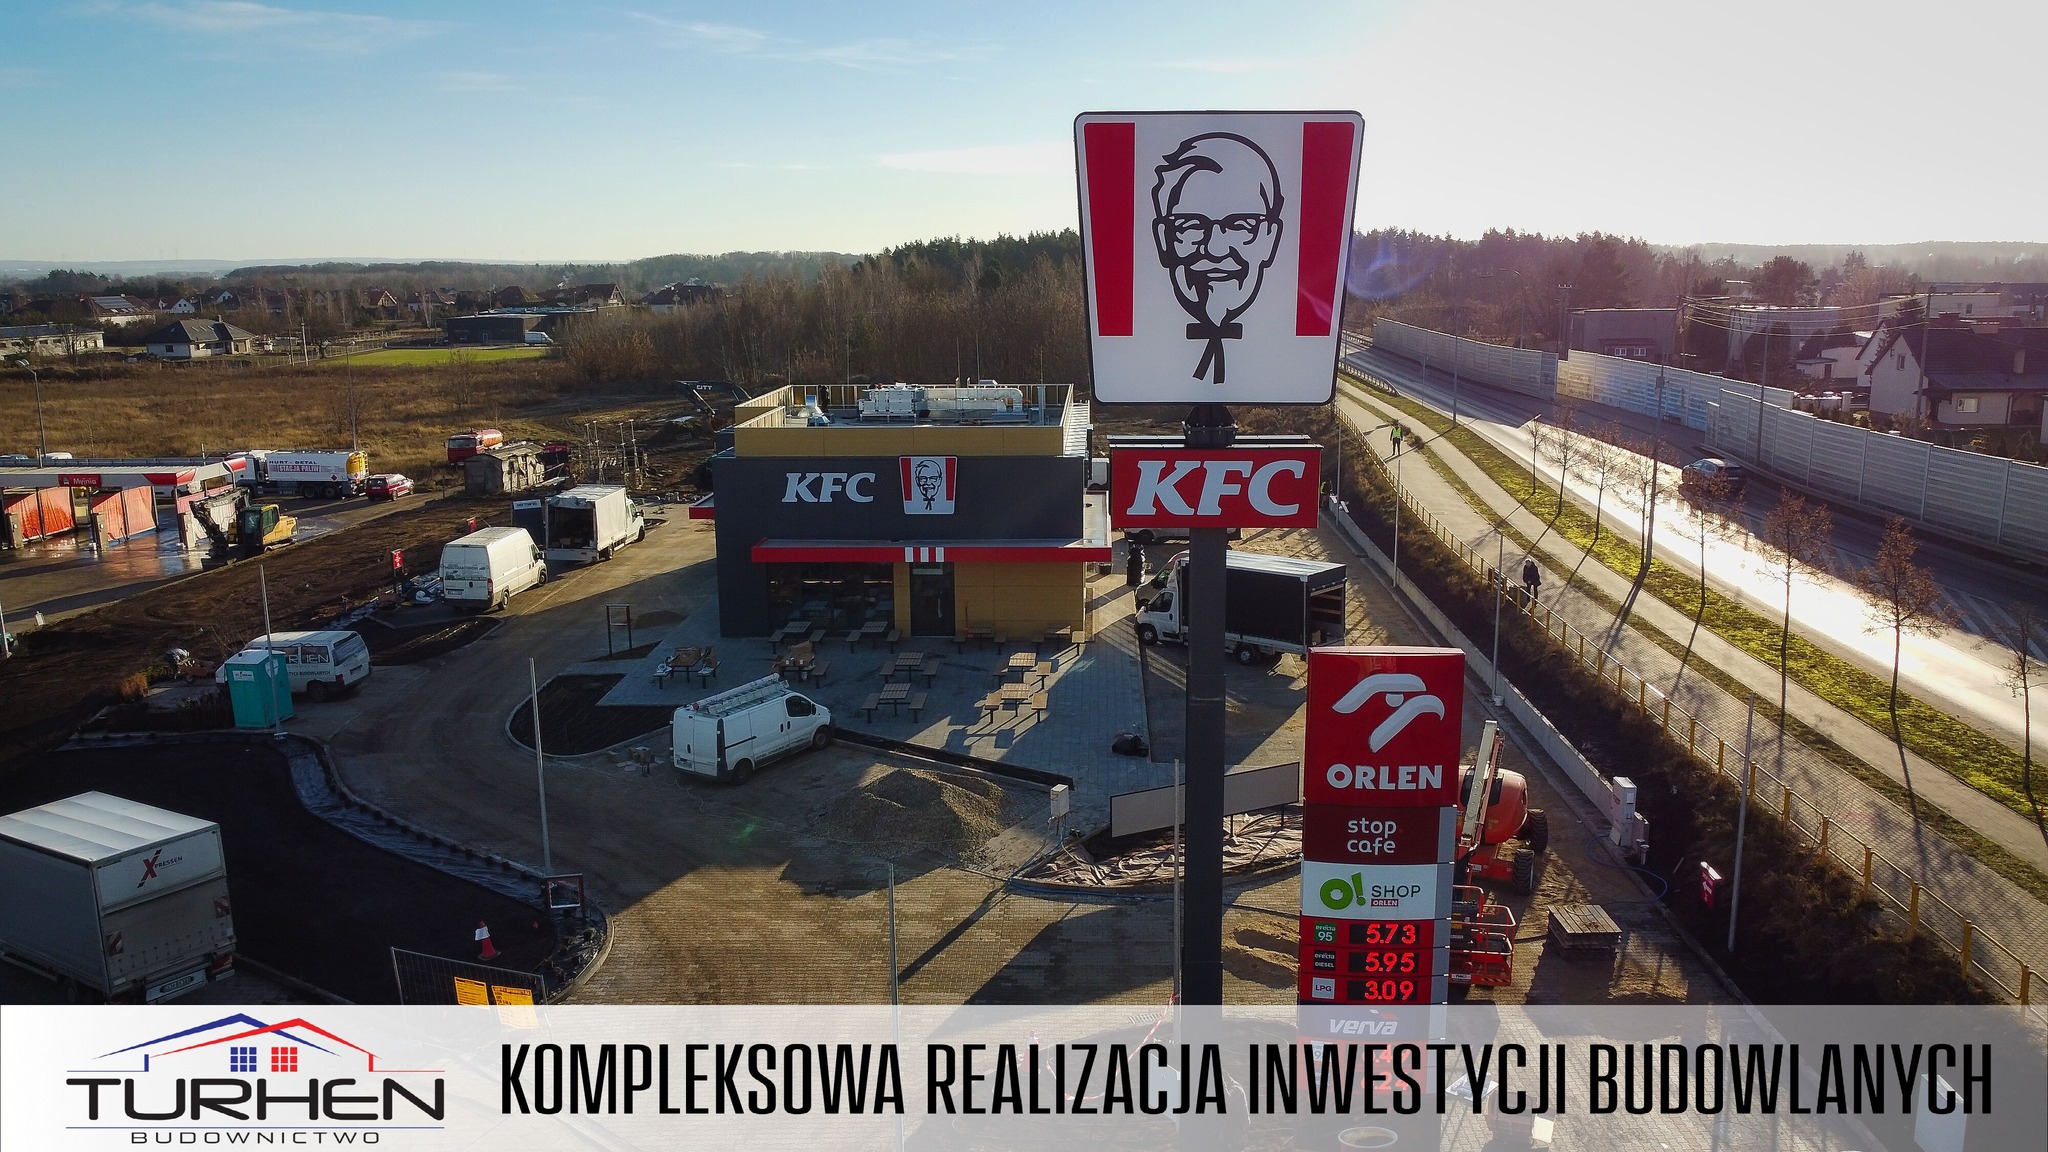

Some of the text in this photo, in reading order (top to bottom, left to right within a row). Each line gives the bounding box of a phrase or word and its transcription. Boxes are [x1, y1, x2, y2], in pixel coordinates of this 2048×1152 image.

[781, 472, 876, 503] KFC
[1126, 460, 1306, 516] KFC
[1326, 763, 1443, 790] ORLEN
[1347, 817, 1397, 839] stop
[1347, 837, 1396, 855] cafe
[1371, 884, 1421, 898] SHOP
[1318, 931, 1333, 942] 95
[1366, 923, 1416, 944] 5.73
[1365, 952, 1415, 972] 5.95
[1364, 980, 1414, 1000] 3.09
[1329, 1018, 1398, 1035] verva
